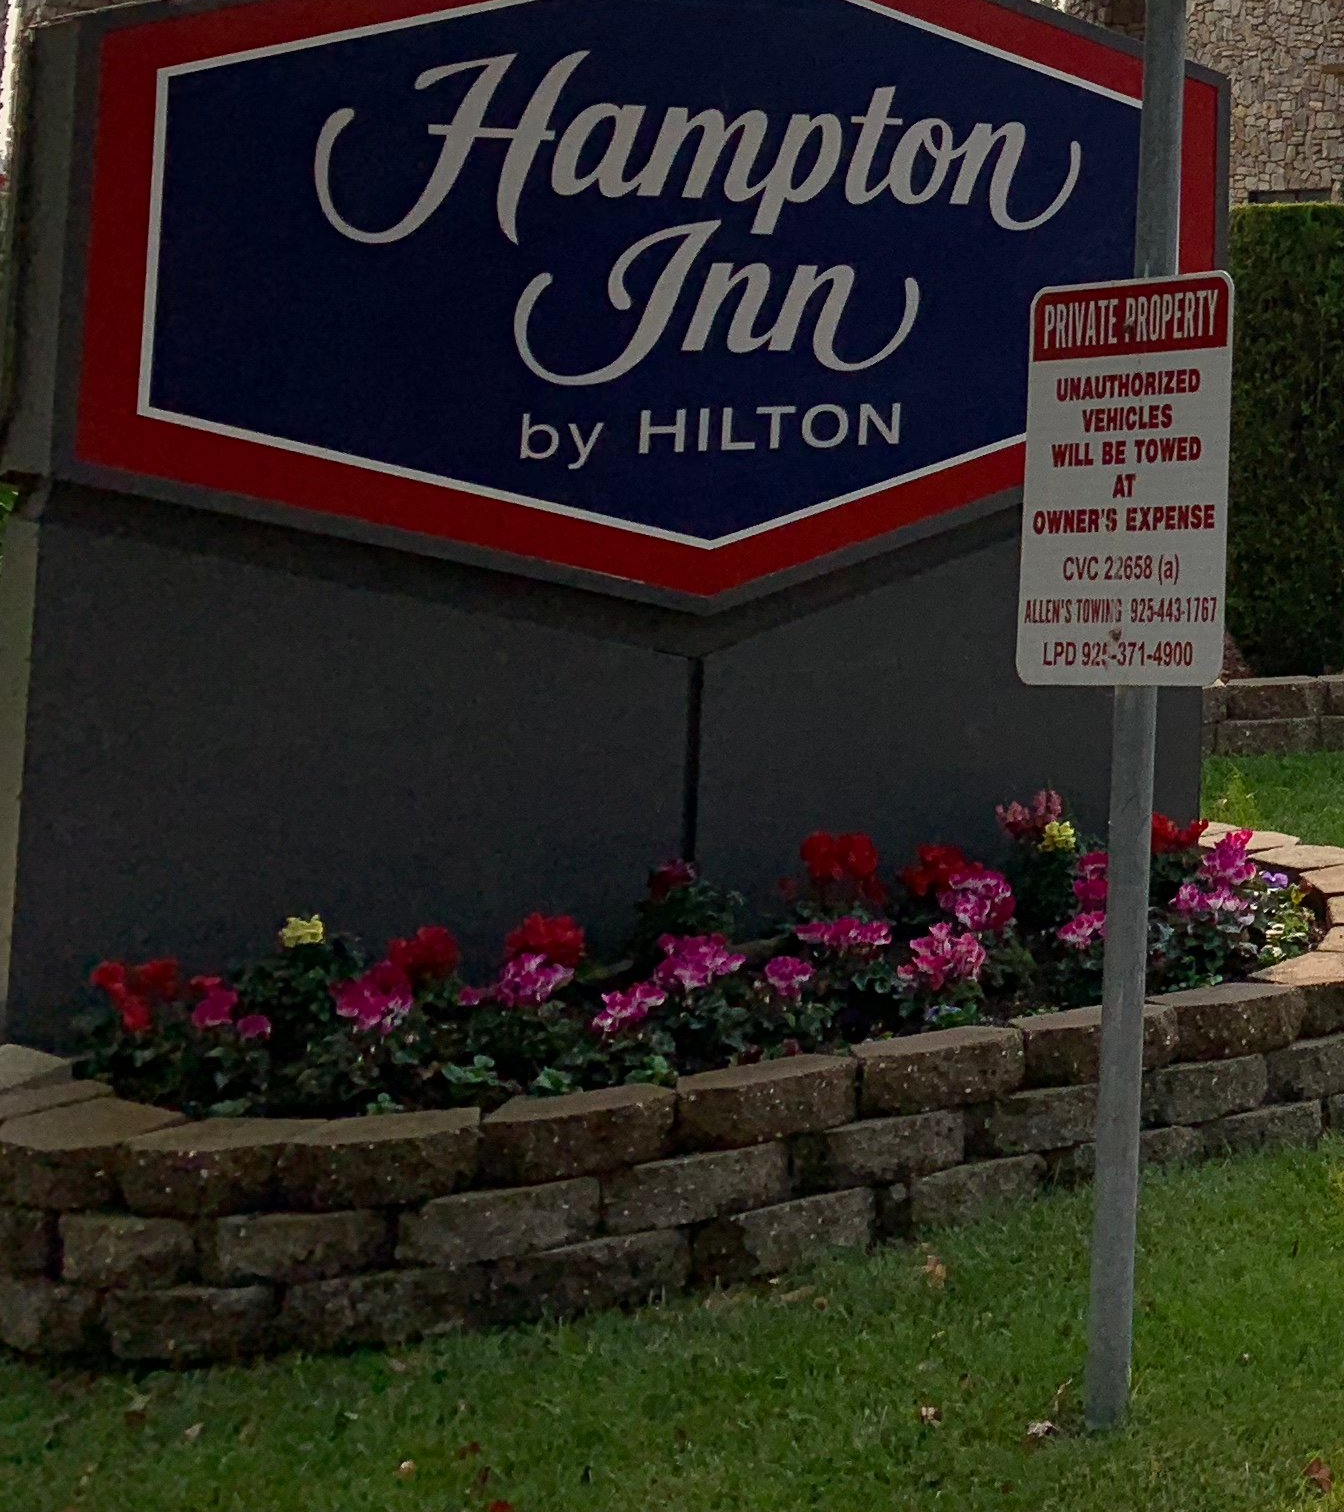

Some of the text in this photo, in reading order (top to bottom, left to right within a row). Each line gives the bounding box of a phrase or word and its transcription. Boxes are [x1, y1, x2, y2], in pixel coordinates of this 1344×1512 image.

[313, 49, 1083, 245] Hampton
[513, 220, 920, 386] Inn
[1043, 289, 1219, 350] PRIVATE PROPERTY
[1056, 368, 1200, 402] UNAUTHORIZED
[1082, 404, 1173, 433] VEHICLES
[519, 402, 902, 470] by HILTON
[1051, 436, 1202, 468] WILL BE TOWED
[1112, 473, 1136, 499] AT
[1032, 504, 1216, 535] OWNER'S EXPENSE
[1063, 554, 1180, 585] CVC 22658 (a)
[1024, 596, 1217, 625] ALLEN'S TOWING 925-443-1767
[1043, 642, 1076, 666] LPD
